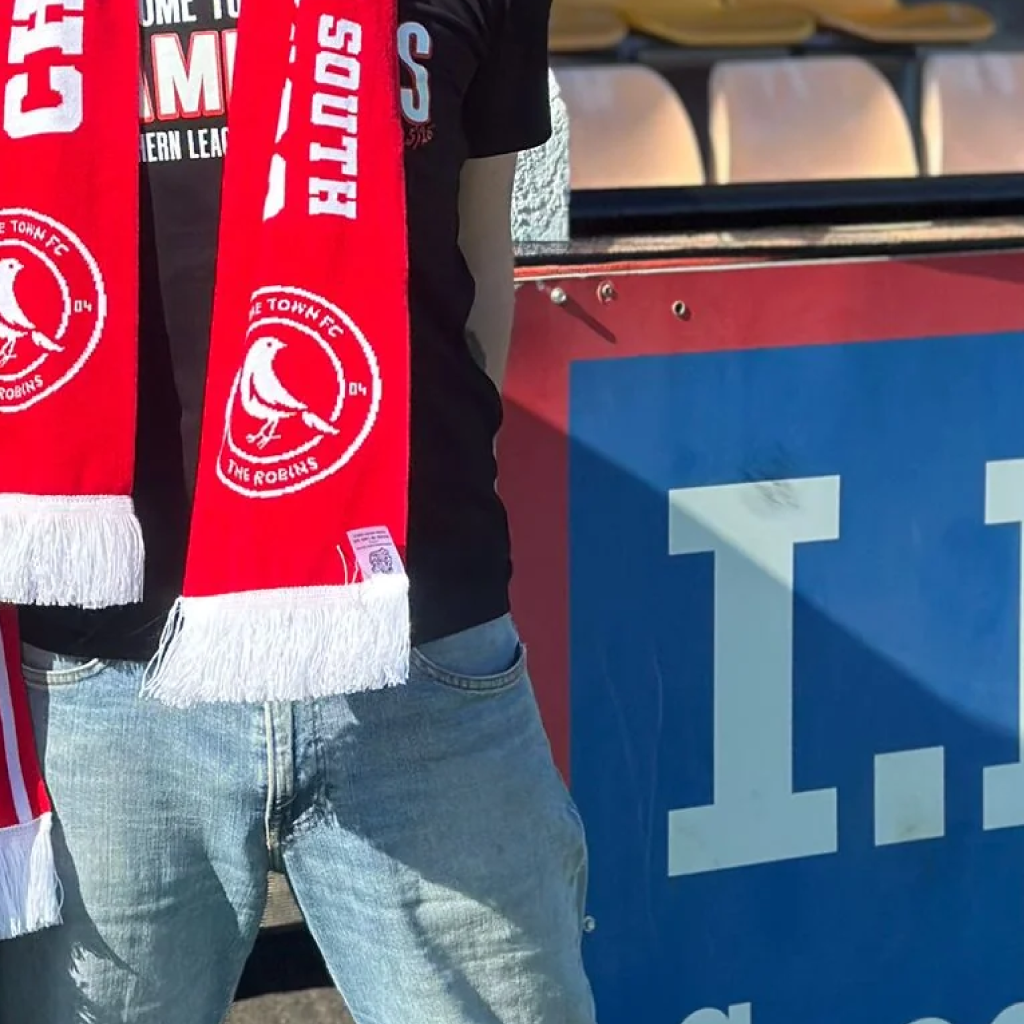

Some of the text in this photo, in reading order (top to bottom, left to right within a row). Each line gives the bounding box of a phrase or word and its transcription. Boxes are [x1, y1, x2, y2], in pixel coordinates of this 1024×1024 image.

[308, 15, 363, 220] SOUTH
[10, 219, 45, 240] TOWN
[45, 233, 70, 256] FC
[266, 297, 321, 321] TOWN
[319, 313, 343, 338] FC
[227, 456, 318, 486] THE ROBINS
[668, 458, 1024, 877] I.
